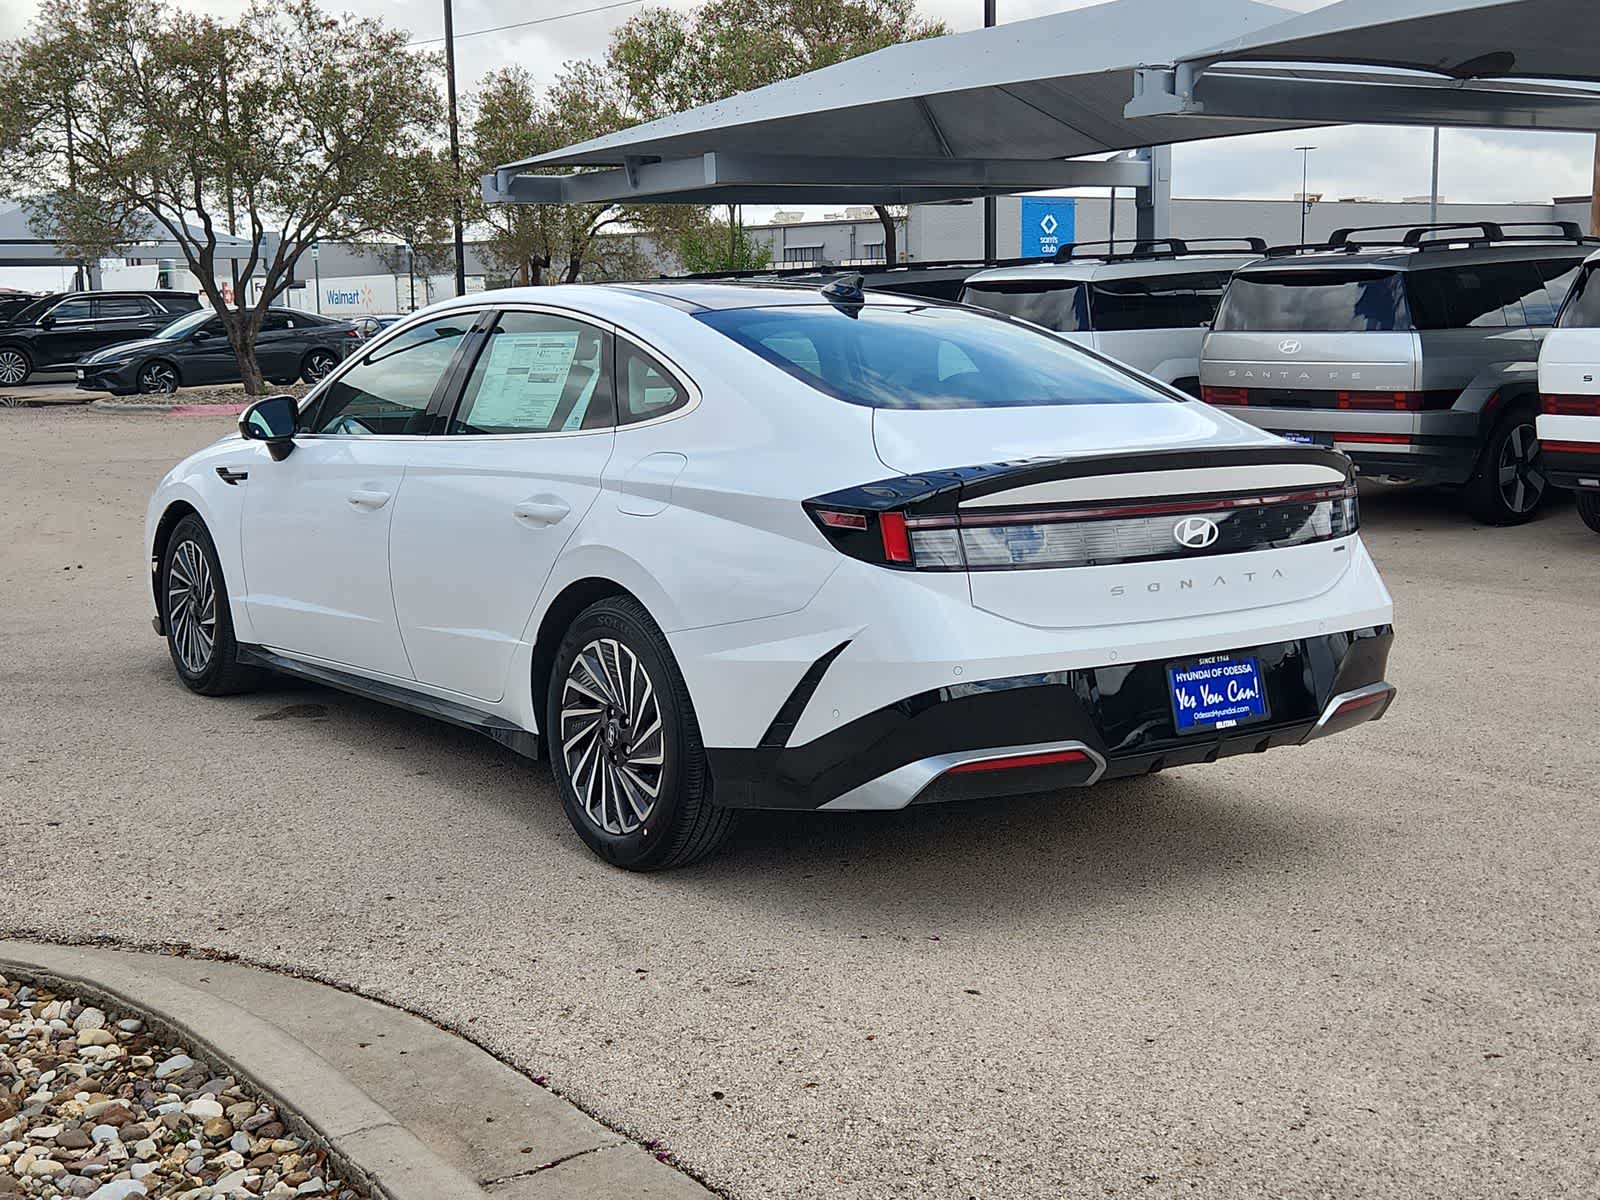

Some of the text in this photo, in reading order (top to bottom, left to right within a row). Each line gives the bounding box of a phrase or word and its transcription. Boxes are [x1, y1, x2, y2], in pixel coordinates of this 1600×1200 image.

[1041, 244, 1057, 253] club
[326, 289, 360, 304] Walmart
[1227, 369, 1361, 380] SANTA FE
[1110, 569, 1283, 596] SONATA
[1175, 663, 1253, 682] HYUNDAI OF ODESSA
[1175, 676, 1259, 710] Yes You Can!
[1193, 706, 1250, 719] OdessaHyundai.com
